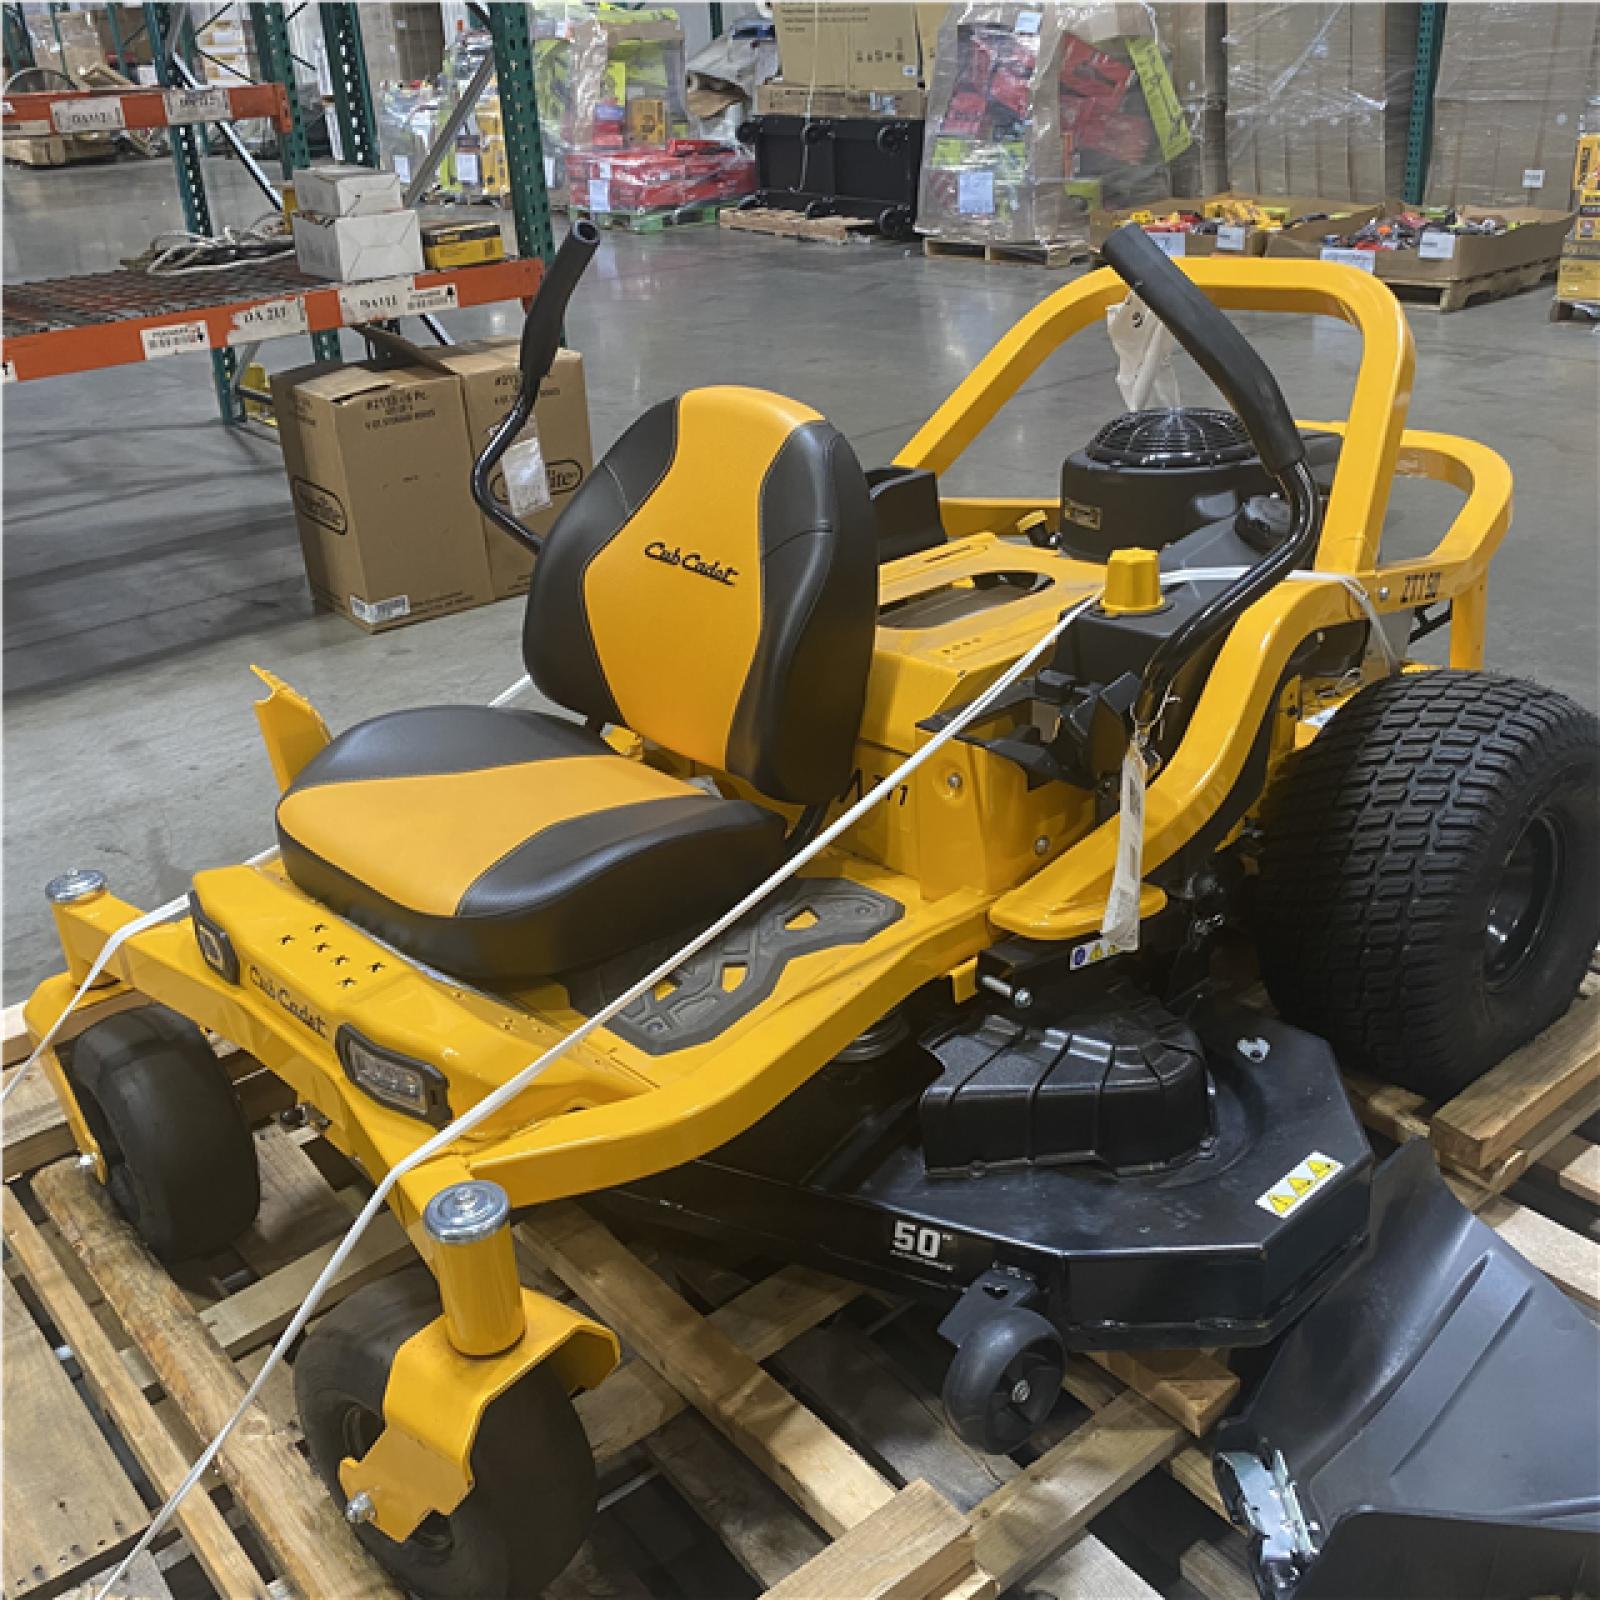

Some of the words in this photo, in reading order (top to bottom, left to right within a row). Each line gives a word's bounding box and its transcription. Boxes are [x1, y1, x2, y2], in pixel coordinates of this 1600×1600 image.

[644, 541, 680, 566] Cub
[682, 553, 739, 586] Cadet
[249, 964, 276, 1001] Cub
[278, 987, 328, 1040] Cadet
